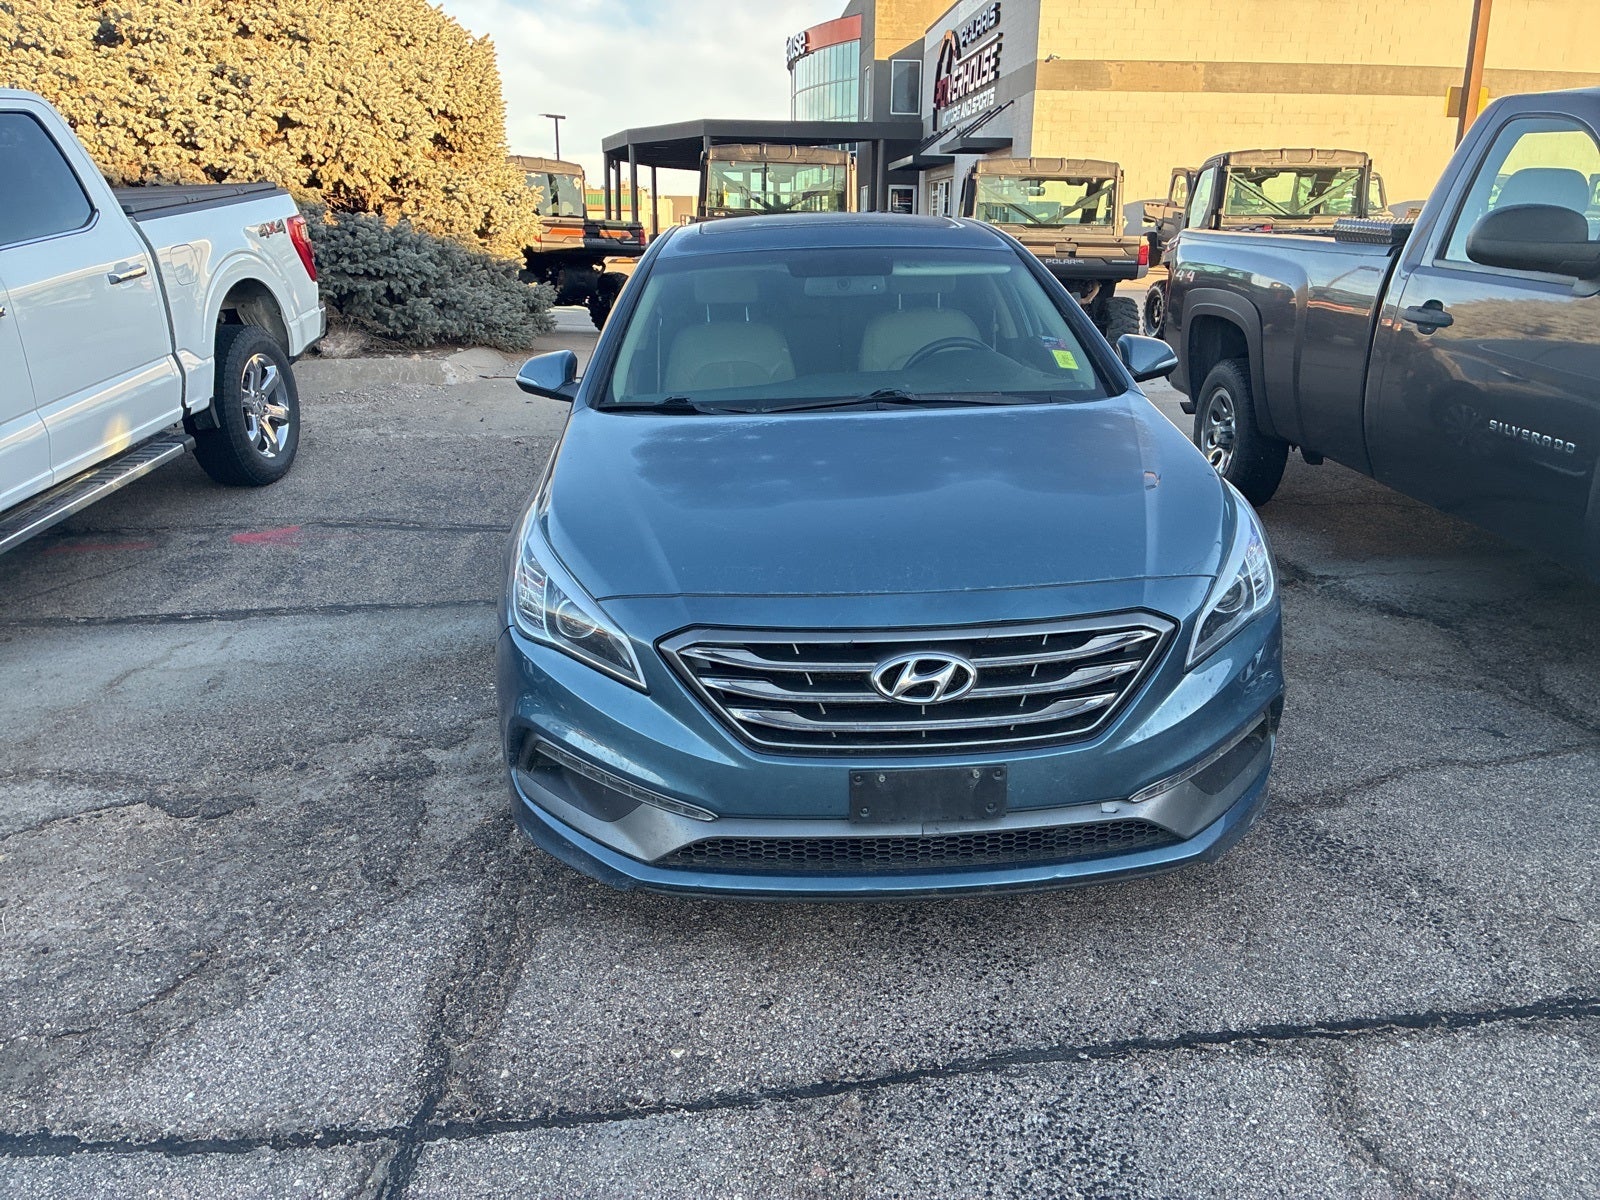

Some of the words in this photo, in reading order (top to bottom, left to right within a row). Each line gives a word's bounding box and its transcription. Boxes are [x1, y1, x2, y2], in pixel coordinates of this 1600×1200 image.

[962, 2, 996, 41] POLARIS
[1175, 269, 1196, 283] 44
[1488, 418, 1576, 454] SILVERADO
